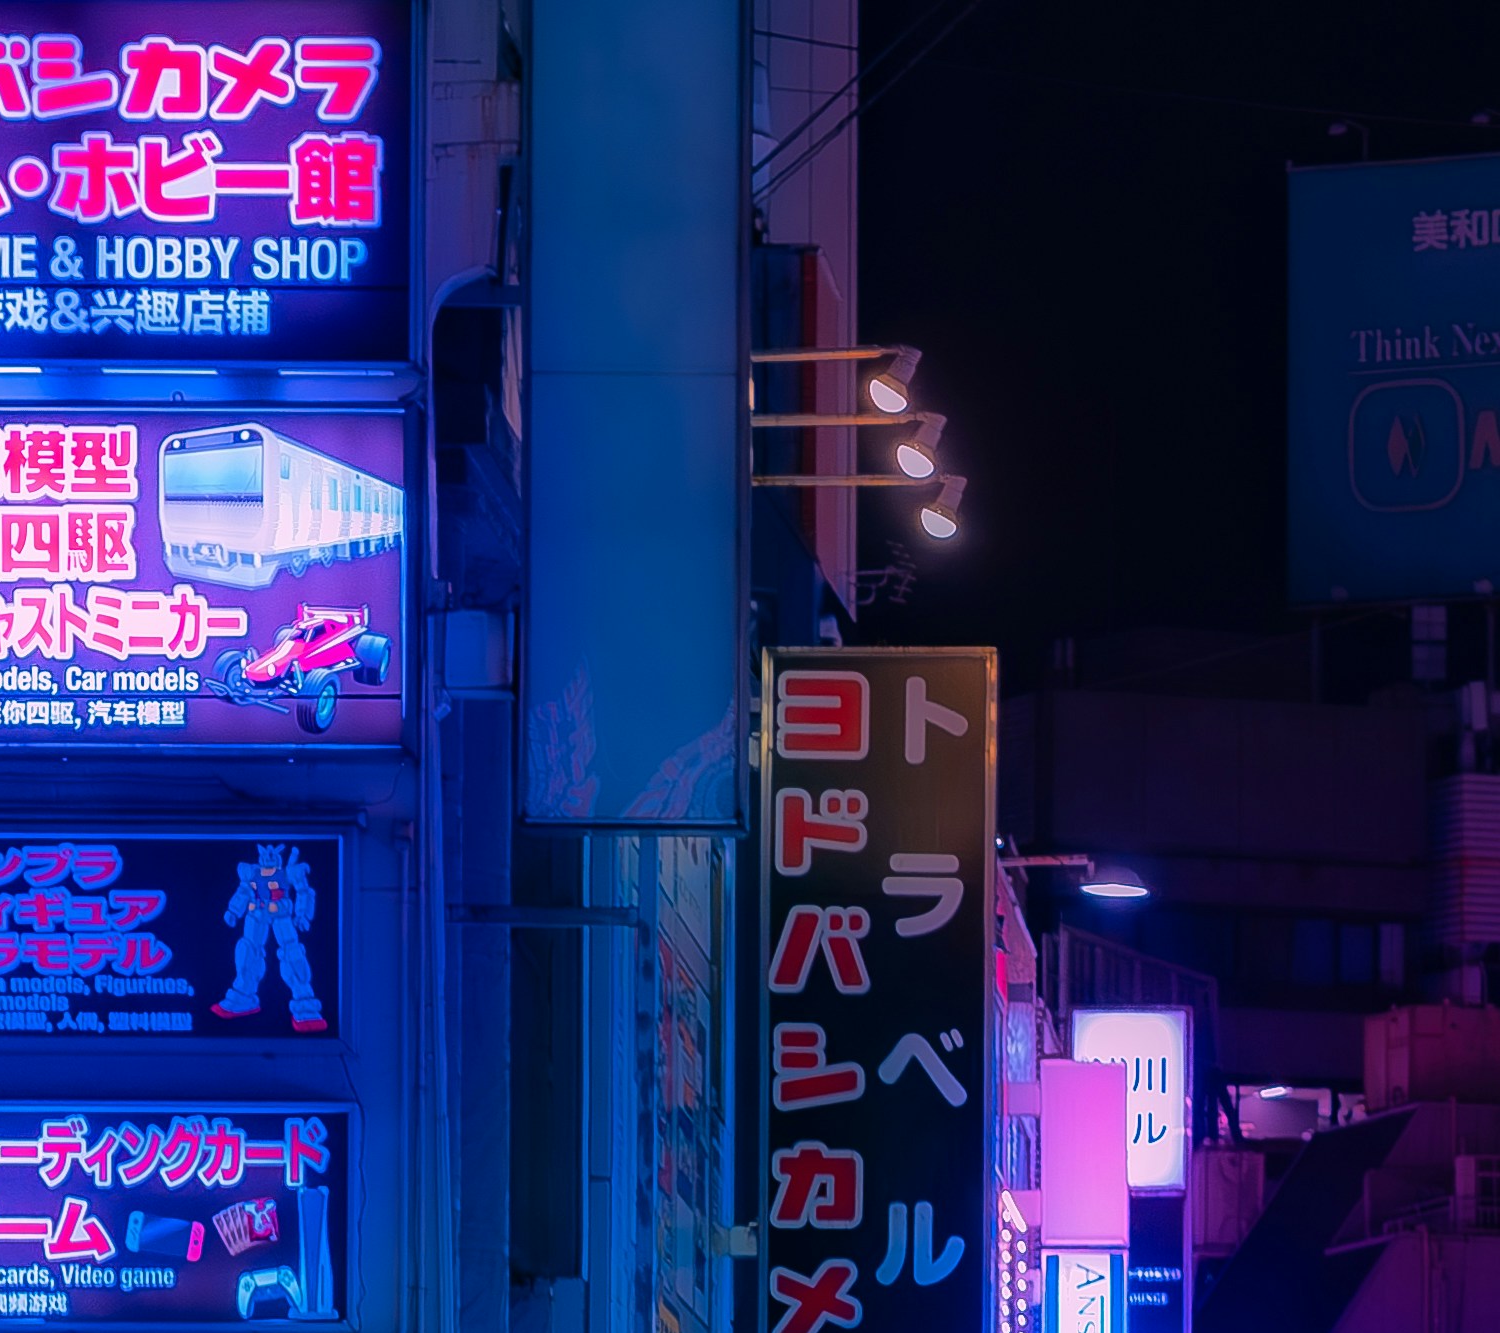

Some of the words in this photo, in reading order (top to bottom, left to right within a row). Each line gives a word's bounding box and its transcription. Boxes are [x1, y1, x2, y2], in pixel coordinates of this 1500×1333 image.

[51, 236, 84, 280] &
[98, 236, 239, 280] HOBBY
[254, 237, 368, 280] SHOP
[1350, 326, 1441, 363] Think
[65, 666, 106, 691] Car
[113, 666, 199, 691] models
[62, 1264, 115, 1287] Video
[121, 1268, 175, 1290] game
